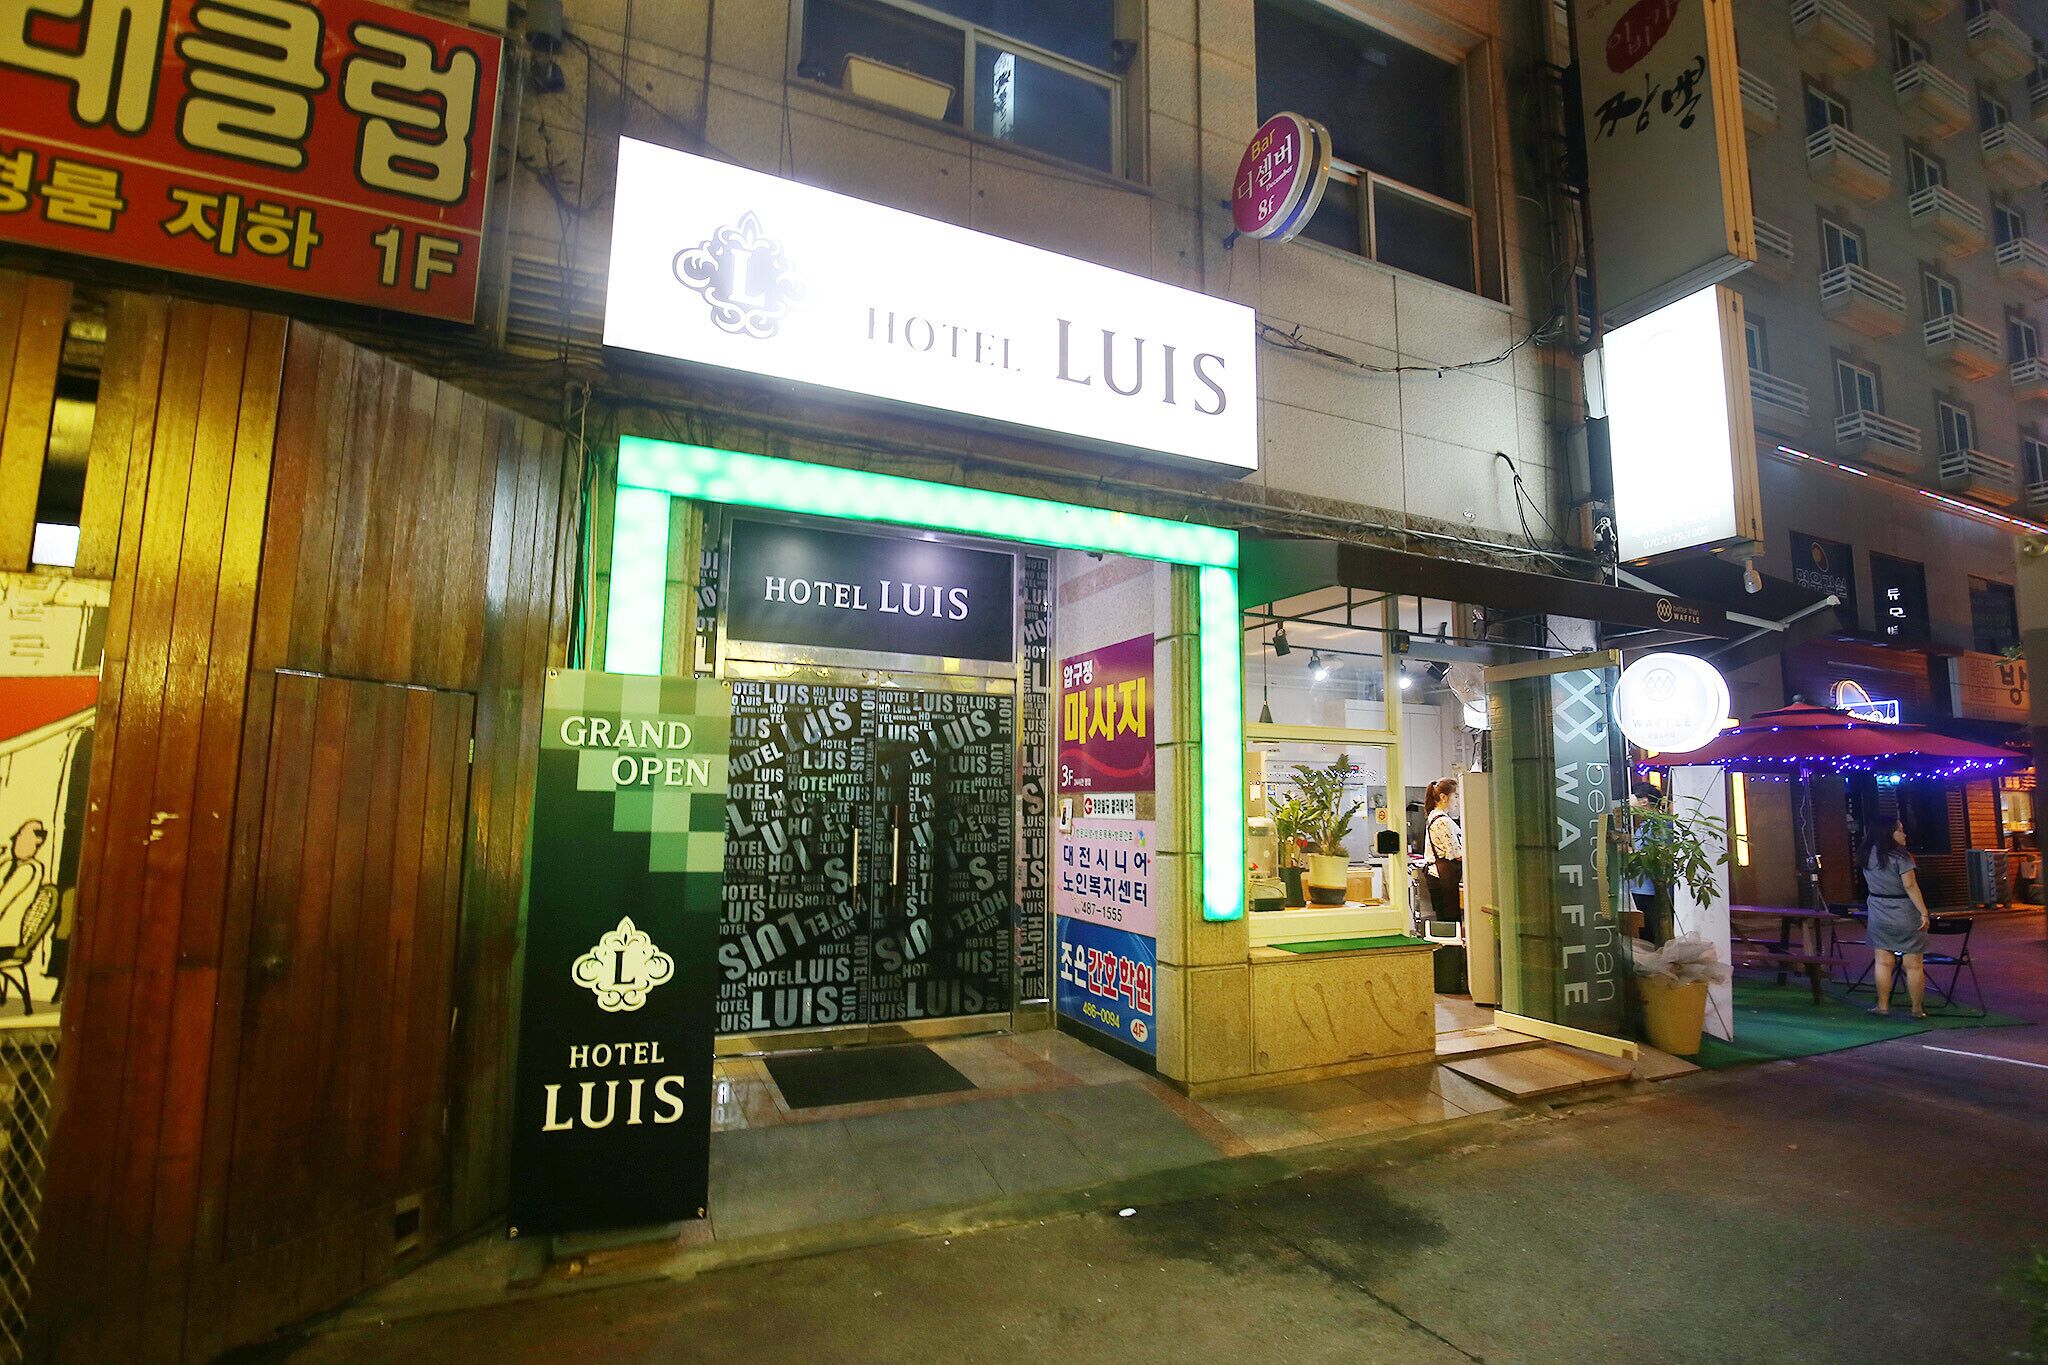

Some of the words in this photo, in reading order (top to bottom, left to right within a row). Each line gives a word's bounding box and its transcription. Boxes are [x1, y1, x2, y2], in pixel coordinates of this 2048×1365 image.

[1251, 129, 1275, 161] Bar
[1238, 133, 1292, 199] 디셈버
[164, 186, 319, 268] 지하
[373, 227, 460, 290] 1F
[867, 306, 1021, 373] HOTEL
[1055, 317, 1227, 416] LUIS
[764, 575, 868, 611] HOTEL
[878, 579, 969, 622] LUIS
[1673, 613, 1701, 624] WAFFLE
[1063, 659, 1094, 689] 압구정
[733, 682, 762, 697] OTEL
[763, 683, 809, 706] LUIS
[828, 687, 859, 703] LUIS
[913, 692, 954, 713] LUIS
[970, 696, 997, 711] LUIS
[1064, 676, 1147, 745] 마사지
[560, 715, 693, 751] GRAND
[731, 717, 771, 739] UIS
[820, 739, 849, 751] HOTEL
[850, 736, 866, 772] LUIS
[963, 745, 988, 755] HOTEL
[728, 741, 784, 778] HOTEL
[802, 750, 847, 771] LUIS
[990, 743, 1004, 775] LUIS
[611, 756, 712, 788] OPEN
[753, 767, 785, 783] LUIS
[832, 772, 865, 785] HOTEL
[974, 776, 1002, 788] HOTEL
[1061, 764, 1075, 787] 3F
[836, 786, 871, 802] LUIS
[979, 789, 1009, 803] LUIS
[1063, 845, 1147, 877] 대전시니어
[1063, 871, 1147, 908] 노인복지센터
[1554, 760, 1589, 1007] WAFFLE
[720, 900, 766, 924] UIS
[768, 893, 804, 910] LUIS
[1081, 901, 1123, 922] 487-1555
[747, 970, 796, 988] HOTEL
[795, 957, 851, 985] LUIS
[716, 982, 747, 999] UIS
[906, 978, 984, 1019] LUIS
[751, 985, 839, 1030] LUIS
[842, 986, 857, 1023] LUIS
[870, 1002, 907, 1022] LUIS
[715, 1012, 751, 1033] UIS
[1132, 1021, 1145, 1038] 4F
[568, 1040, 666, 1069] HOTEL
[541, 1074, 686, 1132] LUIS
